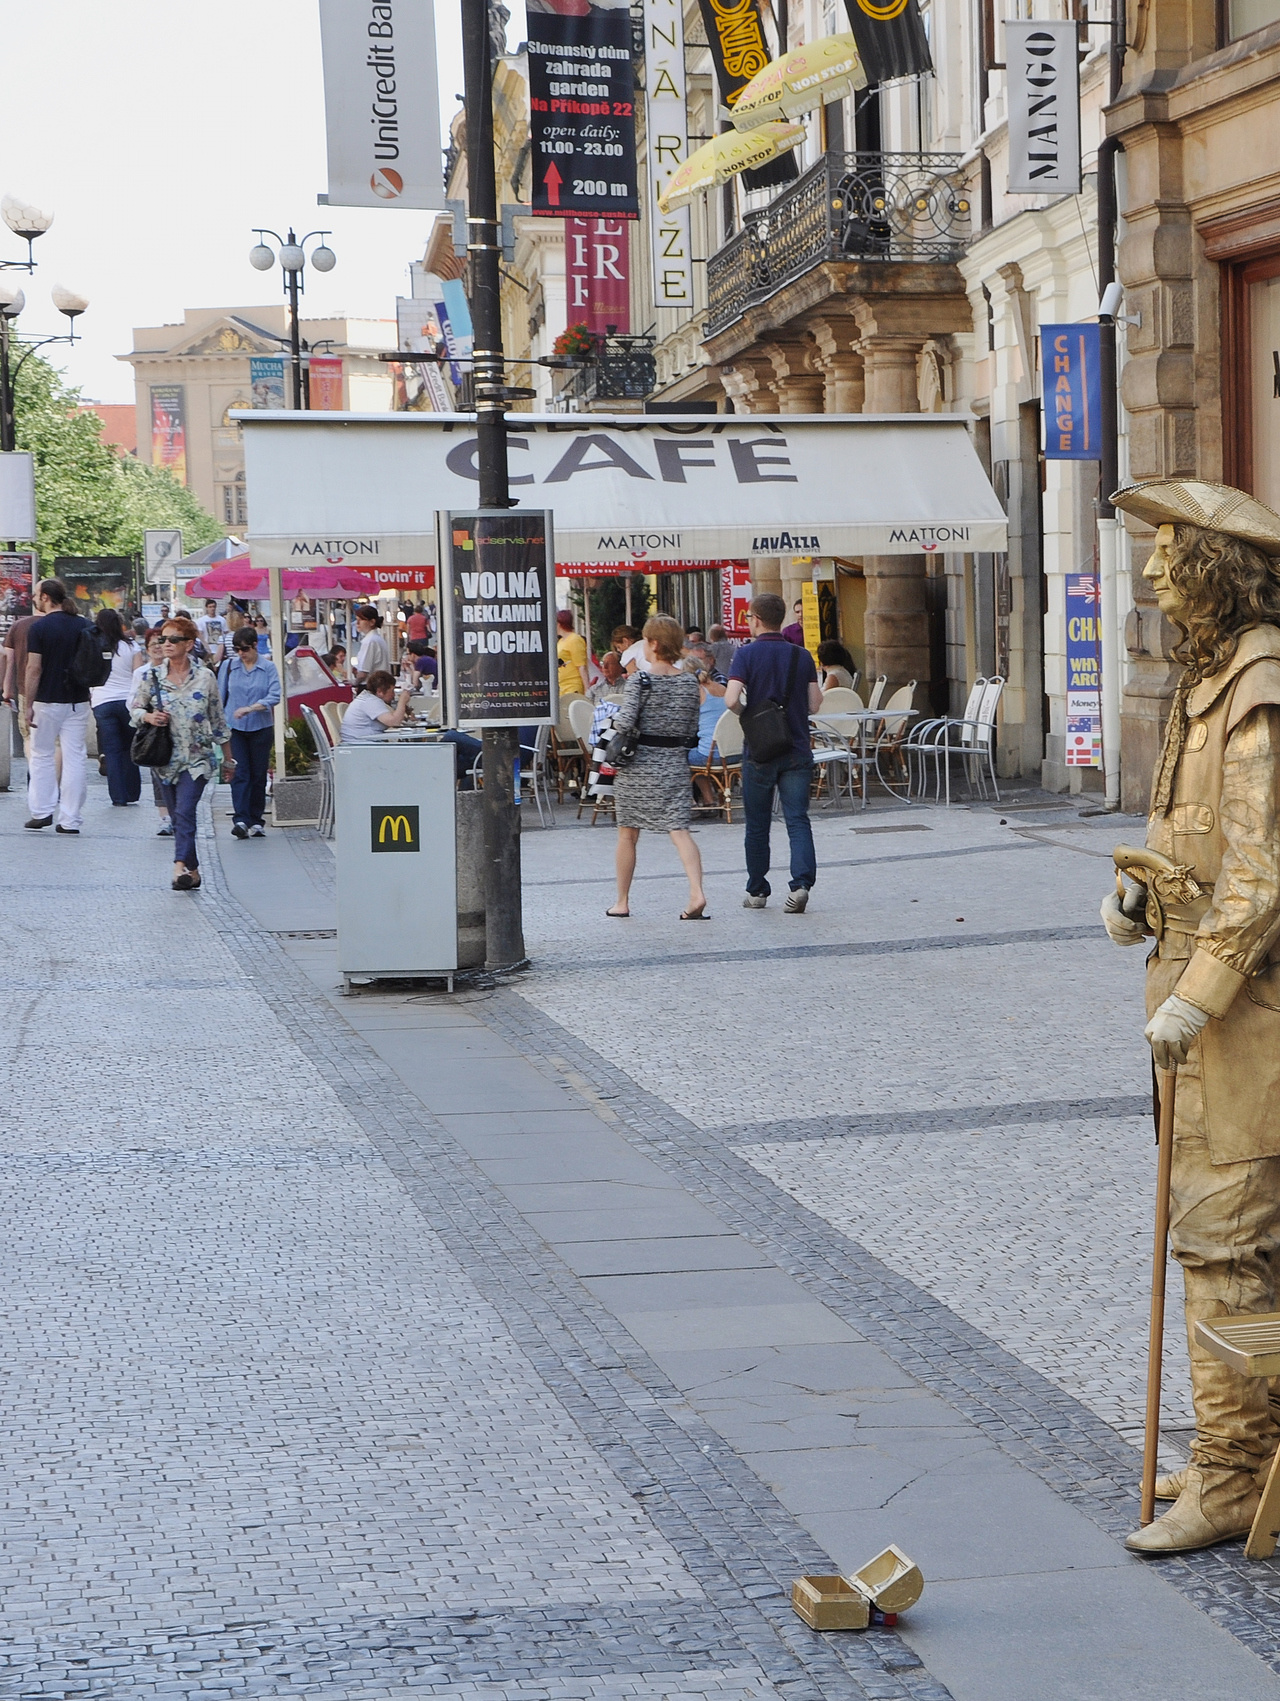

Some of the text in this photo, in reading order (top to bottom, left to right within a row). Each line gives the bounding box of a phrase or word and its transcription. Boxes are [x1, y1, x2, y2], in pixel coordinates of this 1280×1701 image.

[527, 40, 630, 60] Slovanský dům
[545, 60, 612, 78] zahrada
[791, 73, 820, 92] NON
[820, 58, 854, 81] STOP
[367, 0, 399, 160] UniCredit Ba
[549, 81, 609, 97] garden
[530, 97, 633, 116] Na Příkopě 22
[1025, 32, 1059, 180] MANGO
[542, 124, 621, 142] open daily:
[540, 140, 574, 154] 11.00
[583, 142, 624, 156] 23.00
[723, 147, 773, 175] NON STOP
[572, 179, 628, 197] 200 m
[251, 360, 282, 371] MUCHA
[1053, 334, 1074, 451] CHANGE
[446, 434, 799, 486] CAFE
[598, 533, 681, 550] MATTONI
[752, 532, 820, 550] LAVAZZA
[889, 526, 970, 543] MATTONI
[291, 540, 380, 556] MATTONI
[374, 569, 412, 583] lovin'
[461, 566, 541, 599] VOLNÁ
[462, 602, 542, 623] REKLAMNÍ
[463, 630, 543, 653] PLOCHA
